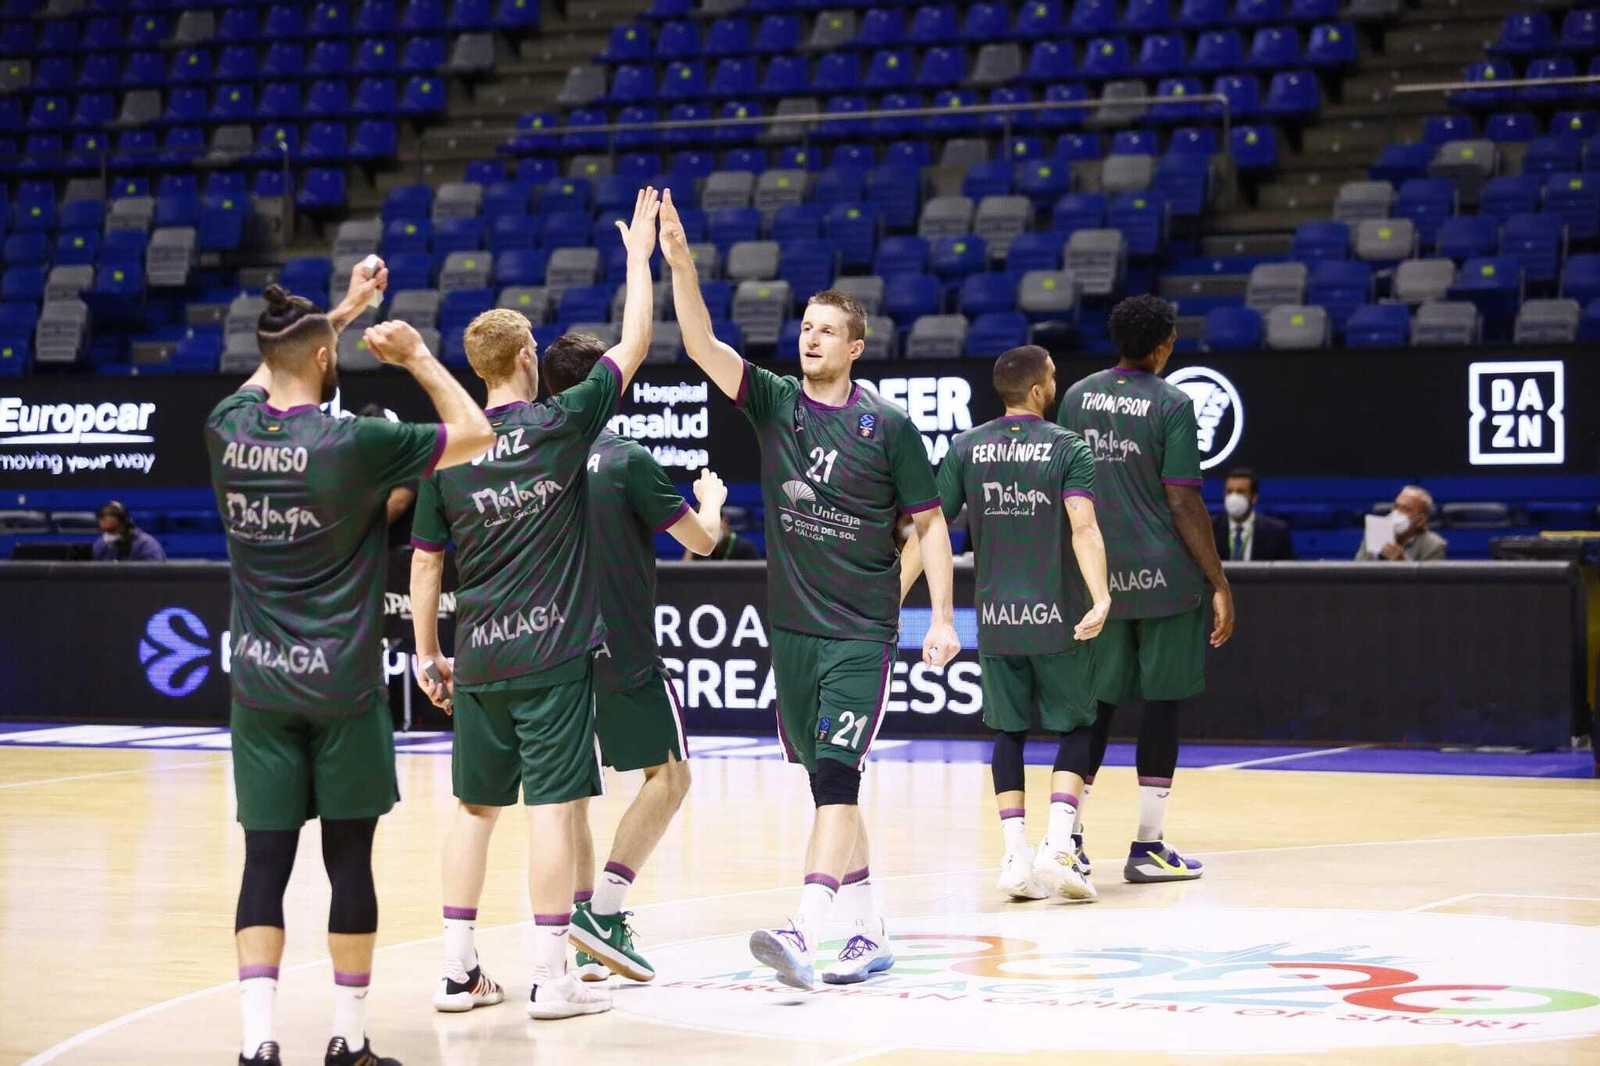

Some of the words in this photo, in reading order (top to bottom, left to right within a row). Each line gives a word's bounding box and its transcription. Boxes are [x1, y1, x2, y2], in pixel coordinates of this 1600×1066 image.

[633, 381, 708, 407] Hospital
[851, 376, 973, 431] EER
[1081, 392, 1151, 417] THOMPSON
[0, 397, 156, 443] Europcar
[605, 406, 709, 439] nsalud
[222, 441, 308, 472] ALONSO
[972, 437, 1053, 464] FERNÁNDEZ
[1083, 428, 1141, 461] Málaga
[0, 451, 63, 474] moving
[66, 454, 111, 474] your
[113, 453, 155, 474] way
[805, 446, 838, 484] 21
[471, 480, 563, 514] Málaga
[982, 481, 1051, 516] Málaga
[226, 492, 321, 541] Málaga
[795, 519, 820, 533] COSTA
[821, 526, 838, 537] DEL
[839, 531, 857, 541] SOL
[812, 504, 861, 526] Unicaja
[472, 602, 565, 648] MALAGA
[982, 602, 1063, 625] MALAGA
[233, 632, 330, 674] MALAGA
[831, 711, 868, 749] 21
[983, 996, 1209, 1013] CAPITAL
[1233, 1008, 1325, 1018] OF
[1336, 1013, 1541, 1029] SPORT
